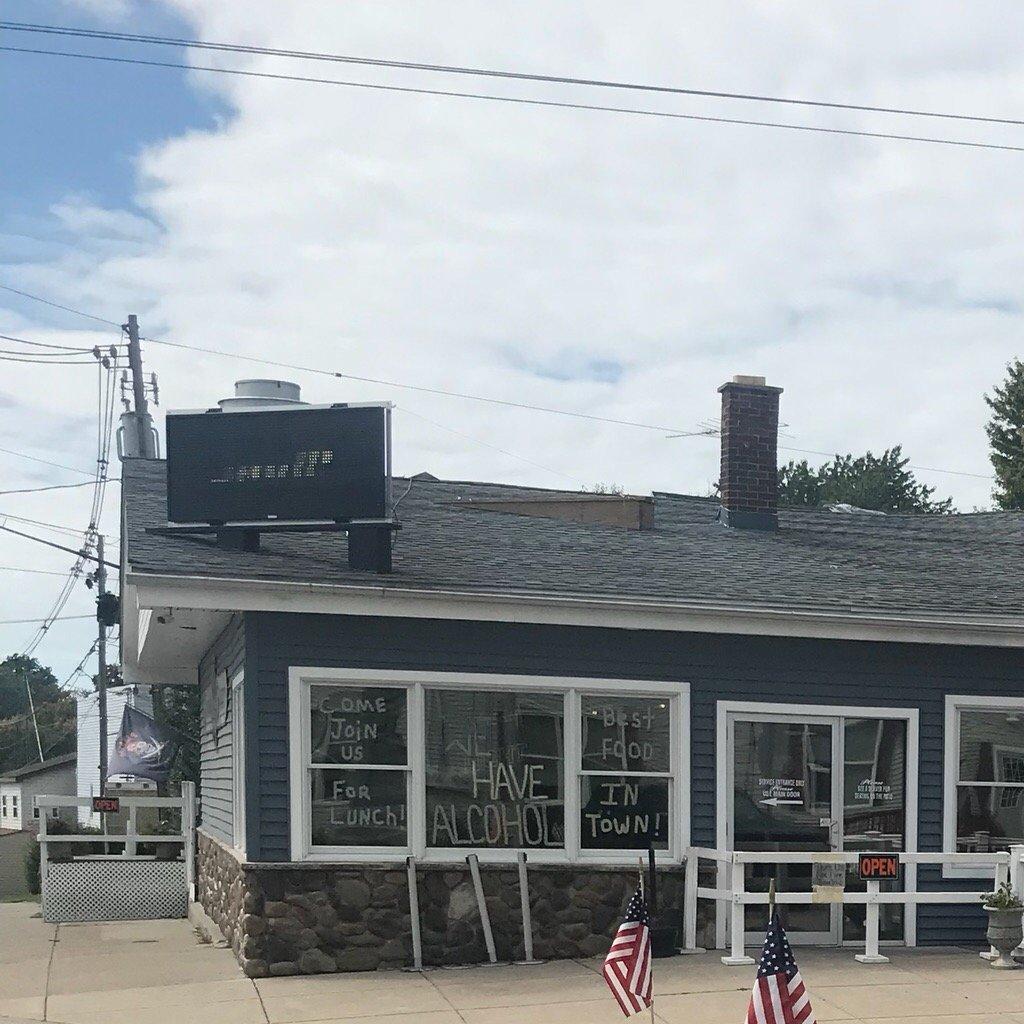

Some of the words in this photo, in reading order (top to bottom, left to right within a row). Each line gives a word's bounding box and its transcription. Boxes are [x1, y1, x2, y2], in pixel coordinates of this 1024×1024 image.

[319, 697, 387, 714] COME
[603, 707, 655, 729] Best
[341, 745, 364, 761] US
[601, 738, 654, 760] FOOD
[472, 760, 549, 800] HAVE
[600, 783, 639, 806] IN
[433, 804, 564, 846] ALCOHOL
[585, 813, 660, 838] TOWN!
[862, 858, 896, 876] OPEN
